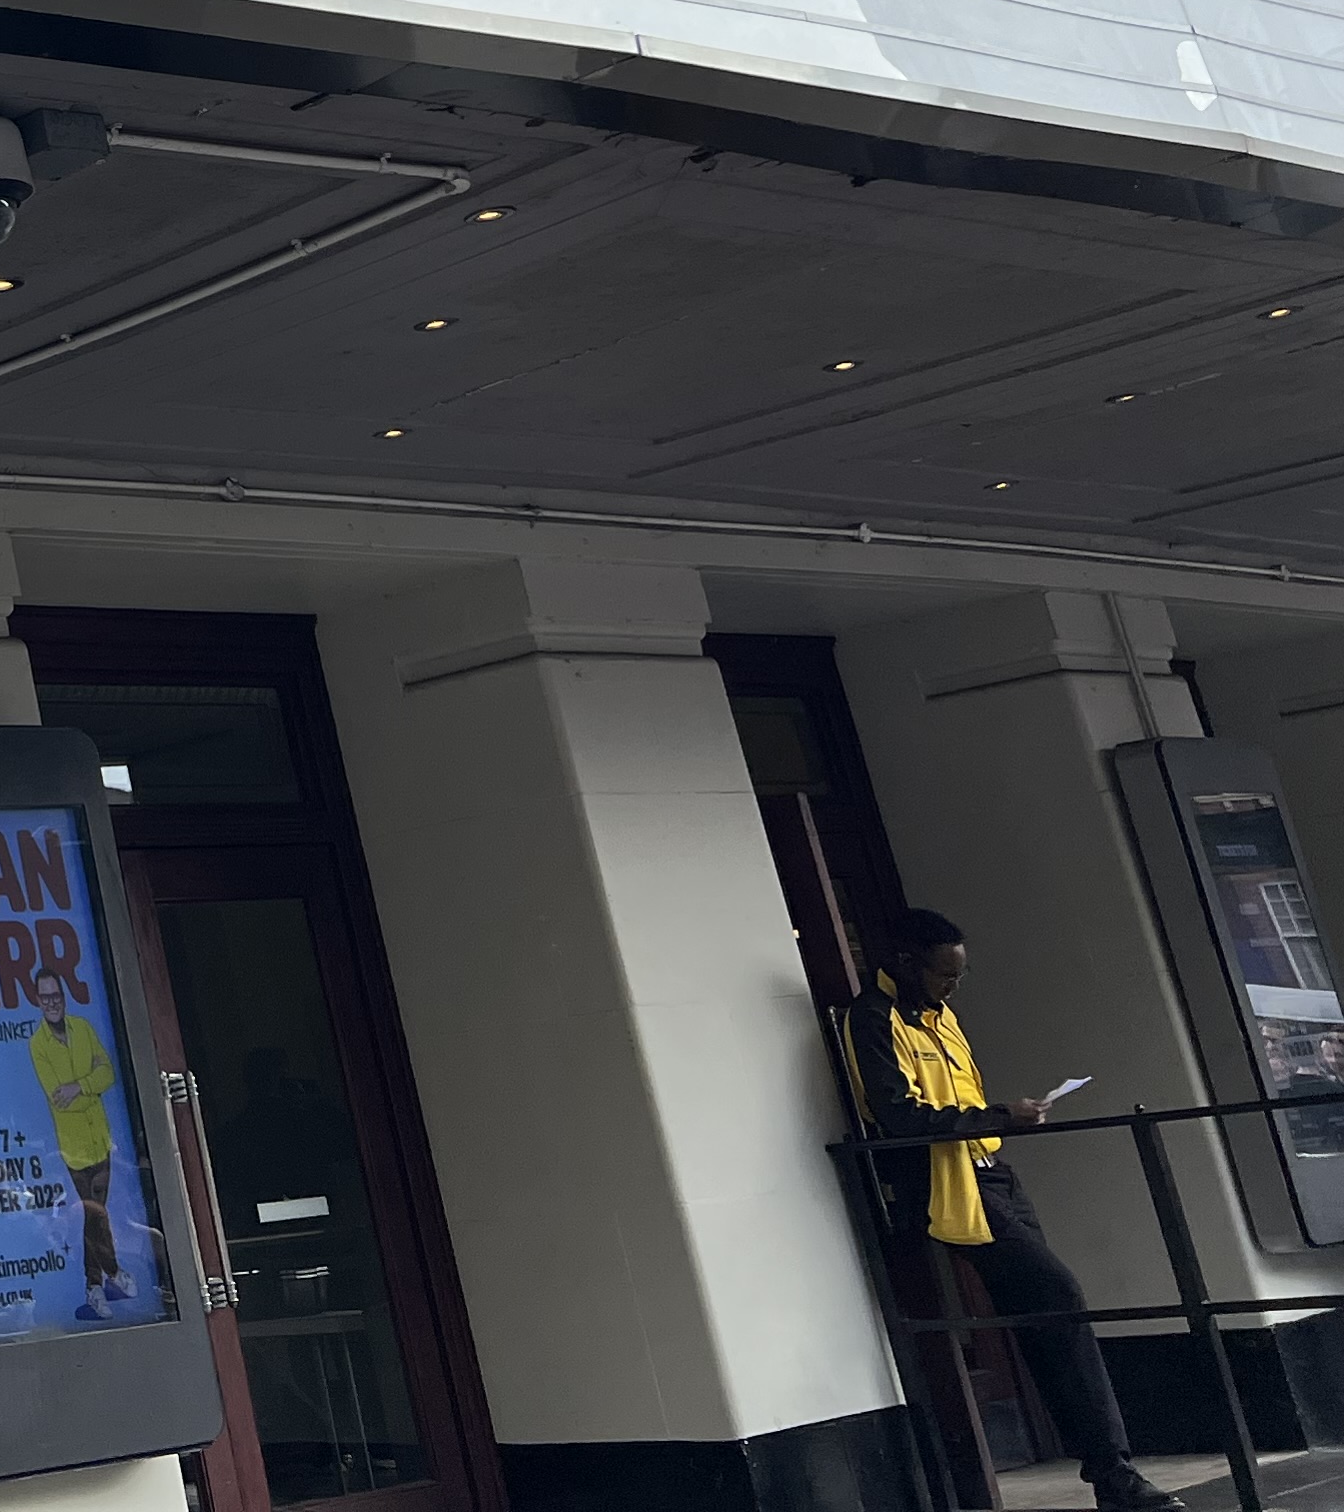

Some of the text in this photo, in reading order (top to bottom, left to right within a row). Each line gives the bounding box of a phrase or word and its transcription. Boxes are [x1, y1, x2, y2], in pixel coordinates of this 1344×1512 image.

[0, 1129, 9, 1152] 7
[29, 1155, 43, 1179] 8
[25, 1183, 67, 1210] 2022
